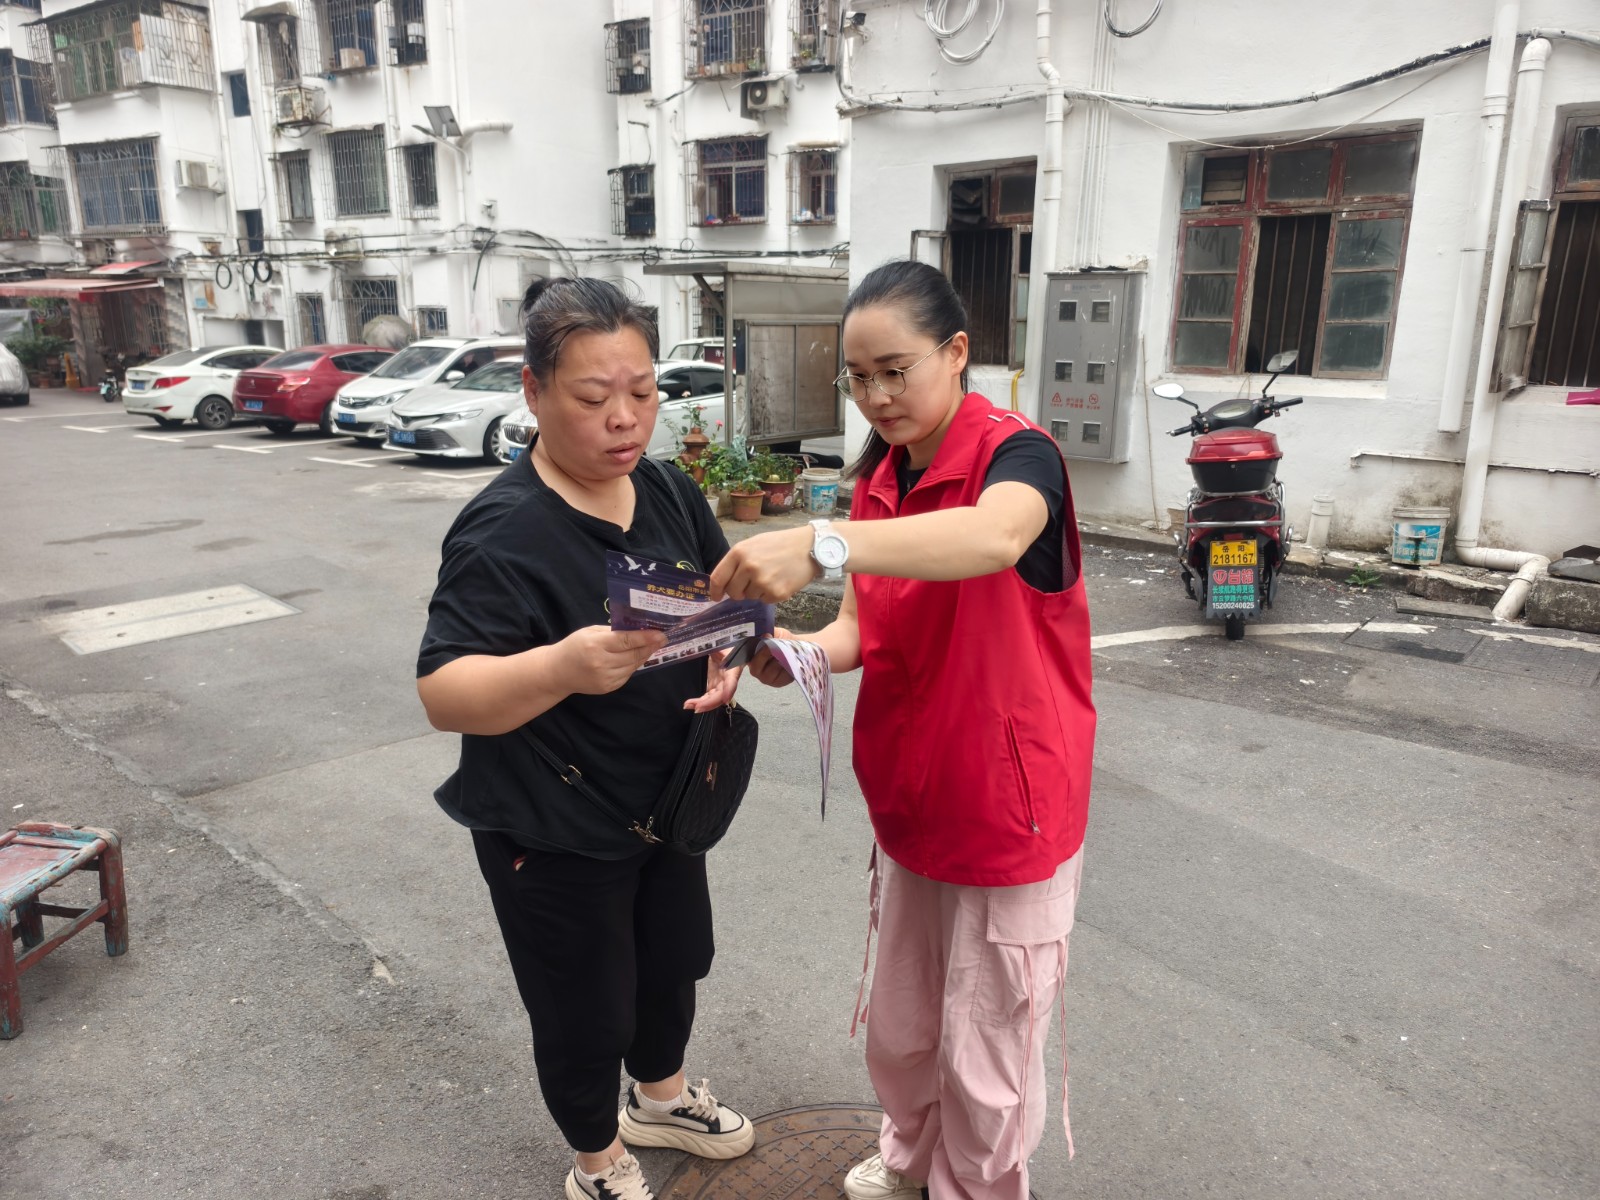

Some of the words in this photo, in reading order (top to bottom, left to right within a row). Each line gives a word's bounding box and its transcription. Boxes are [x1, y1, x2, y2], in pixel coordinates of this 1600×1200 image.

[1213, 554, 1254, 564] 2181167
[1228, 569, 1254, 584] 台铃
[646, 583, 695, 600] 养犬要办证
